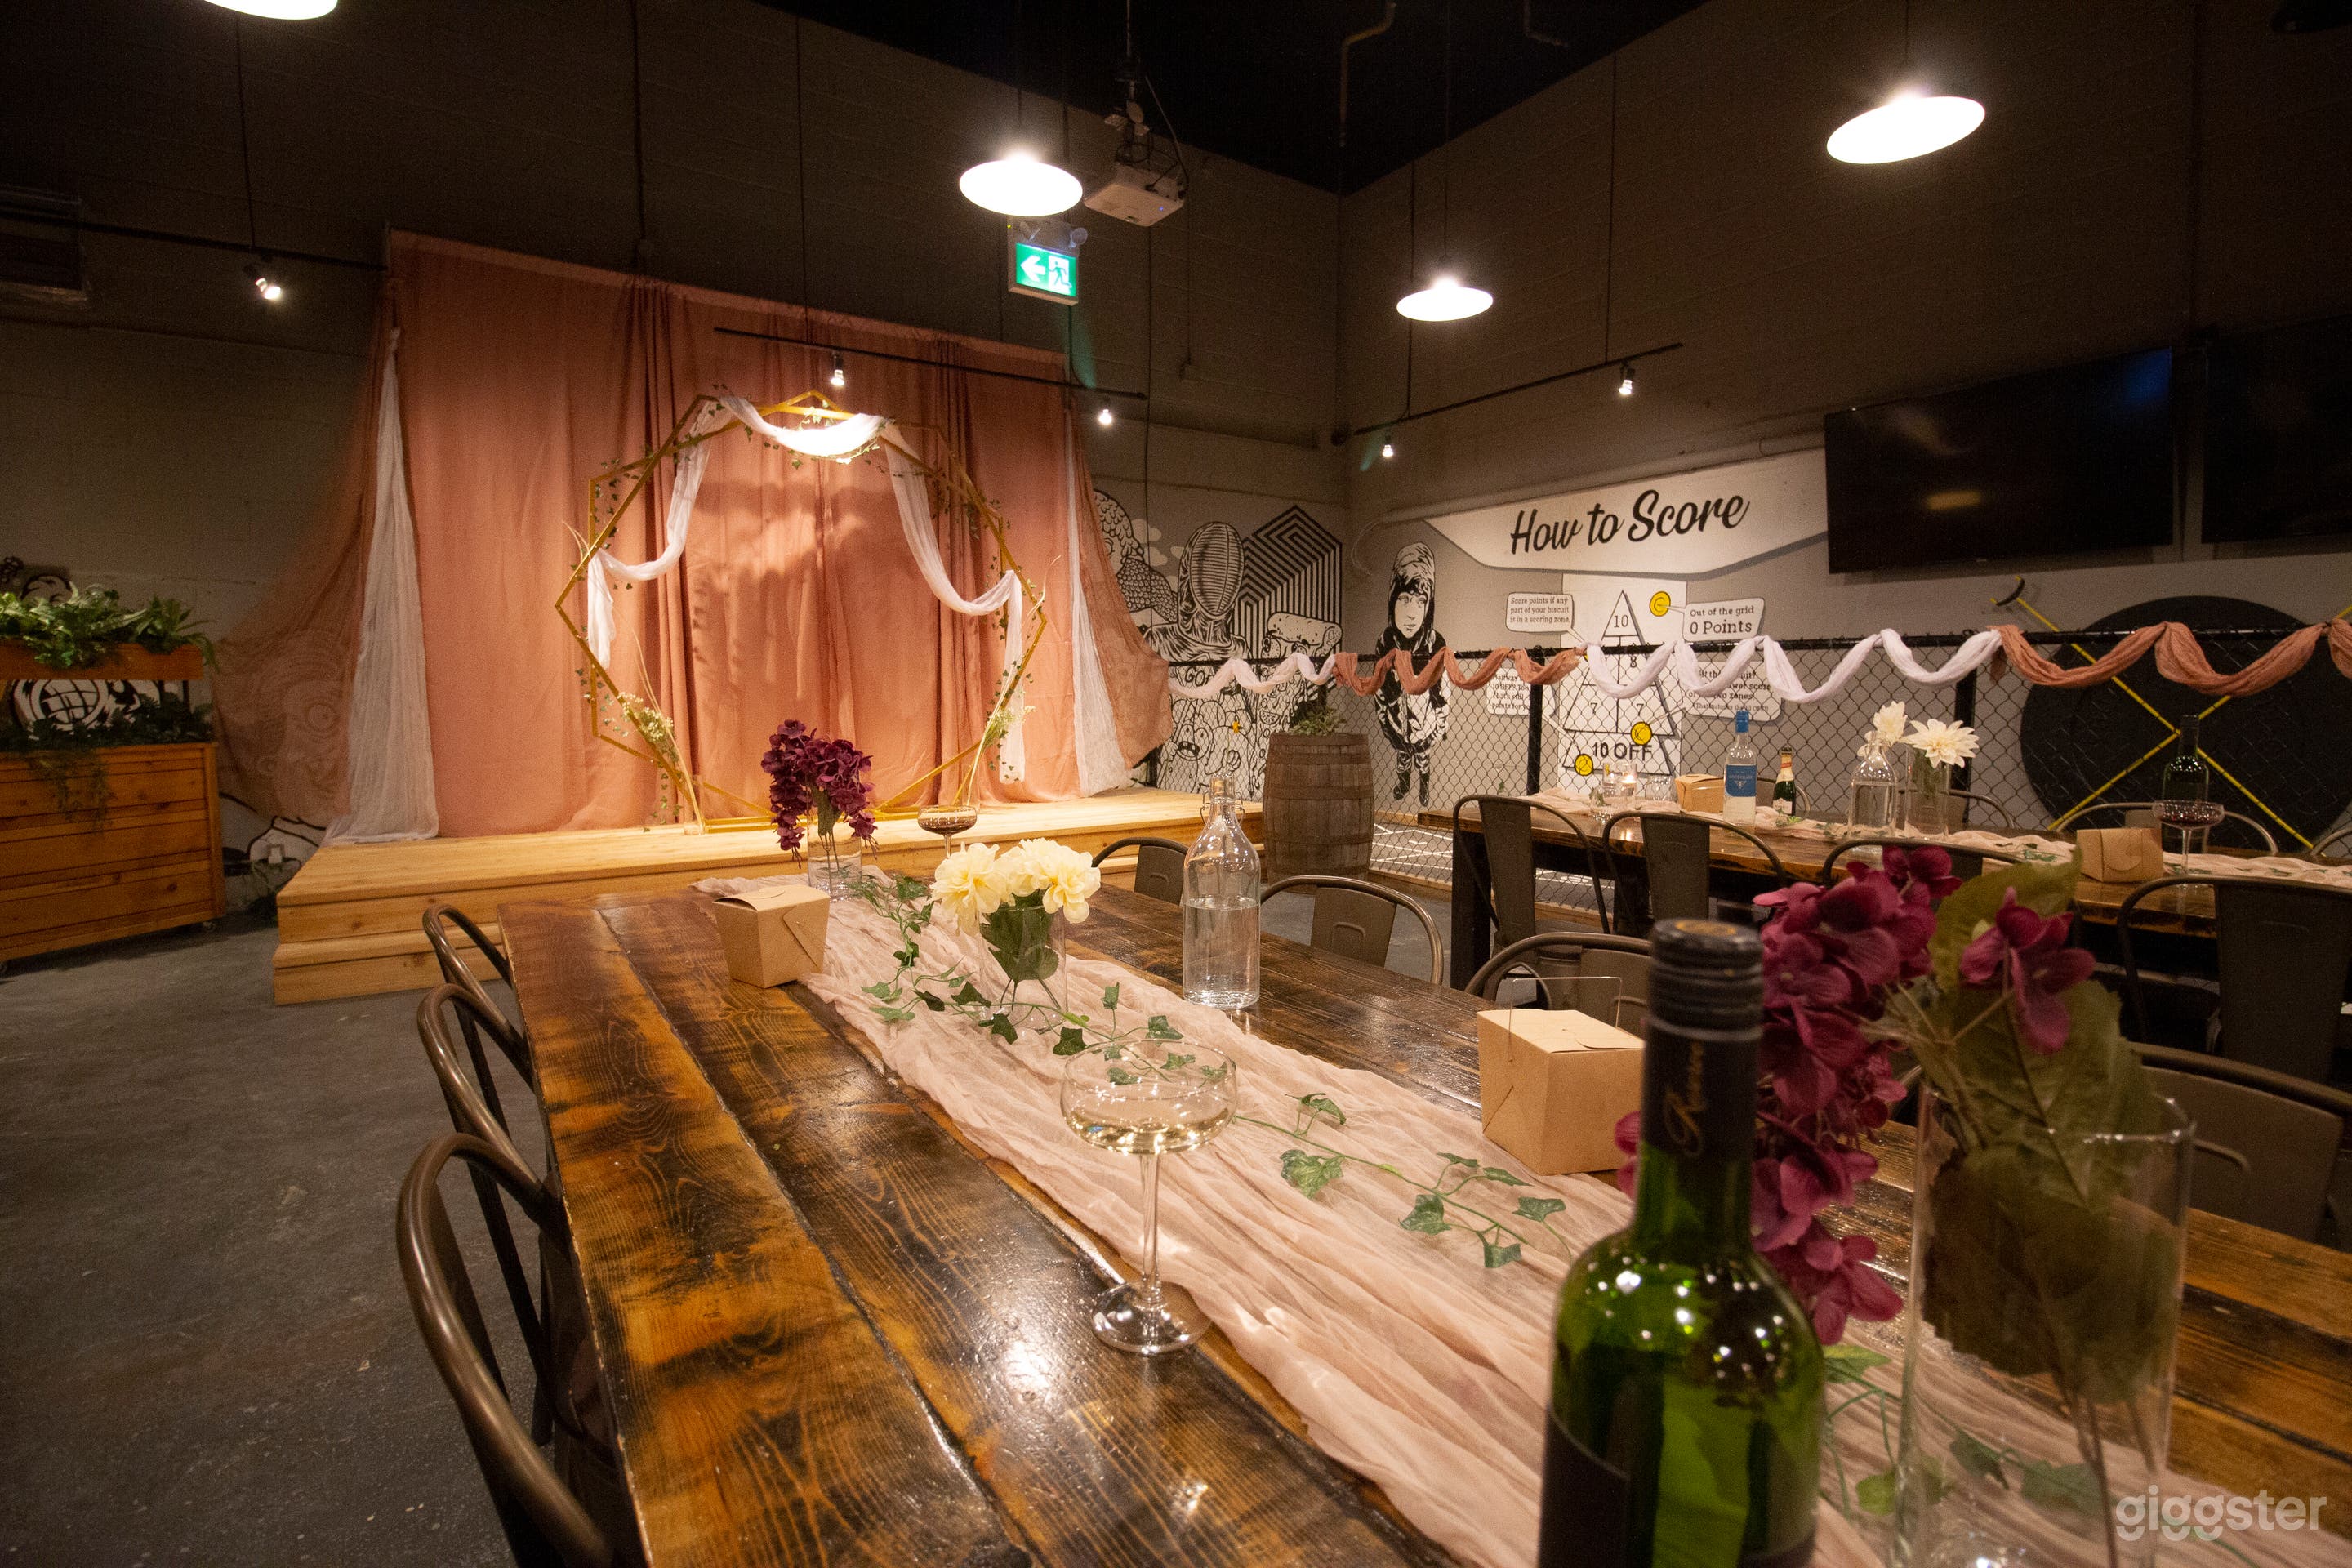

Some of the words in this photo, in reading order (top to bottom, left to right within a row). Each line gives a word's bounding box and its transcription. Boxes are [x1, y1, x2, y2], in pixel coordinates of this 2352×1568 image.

[1511, 509, 1583, 555] How
[1587, 503, 1624, 546] to
[1628, 489, 1750, 542] Score
[1529, 597, 1548, 606] points
[1708, 608, 1717, 616] of
[1719, 607, 1733, 615] the
[1735, 605, 1754, 617] grid
[1530, 615, 1552, 623] scoring
[1614, 614, 1629, 628] 10
[1690, 621, 1698, 635] 0
[1703, 619, 1753, 635] Points
[1591, 702, 1598, 715] 7
[1636, 703, 1644, 716] 7
[1592, 742, 1609, 758] 10
[1614, 742, 1652, 761] OFF
